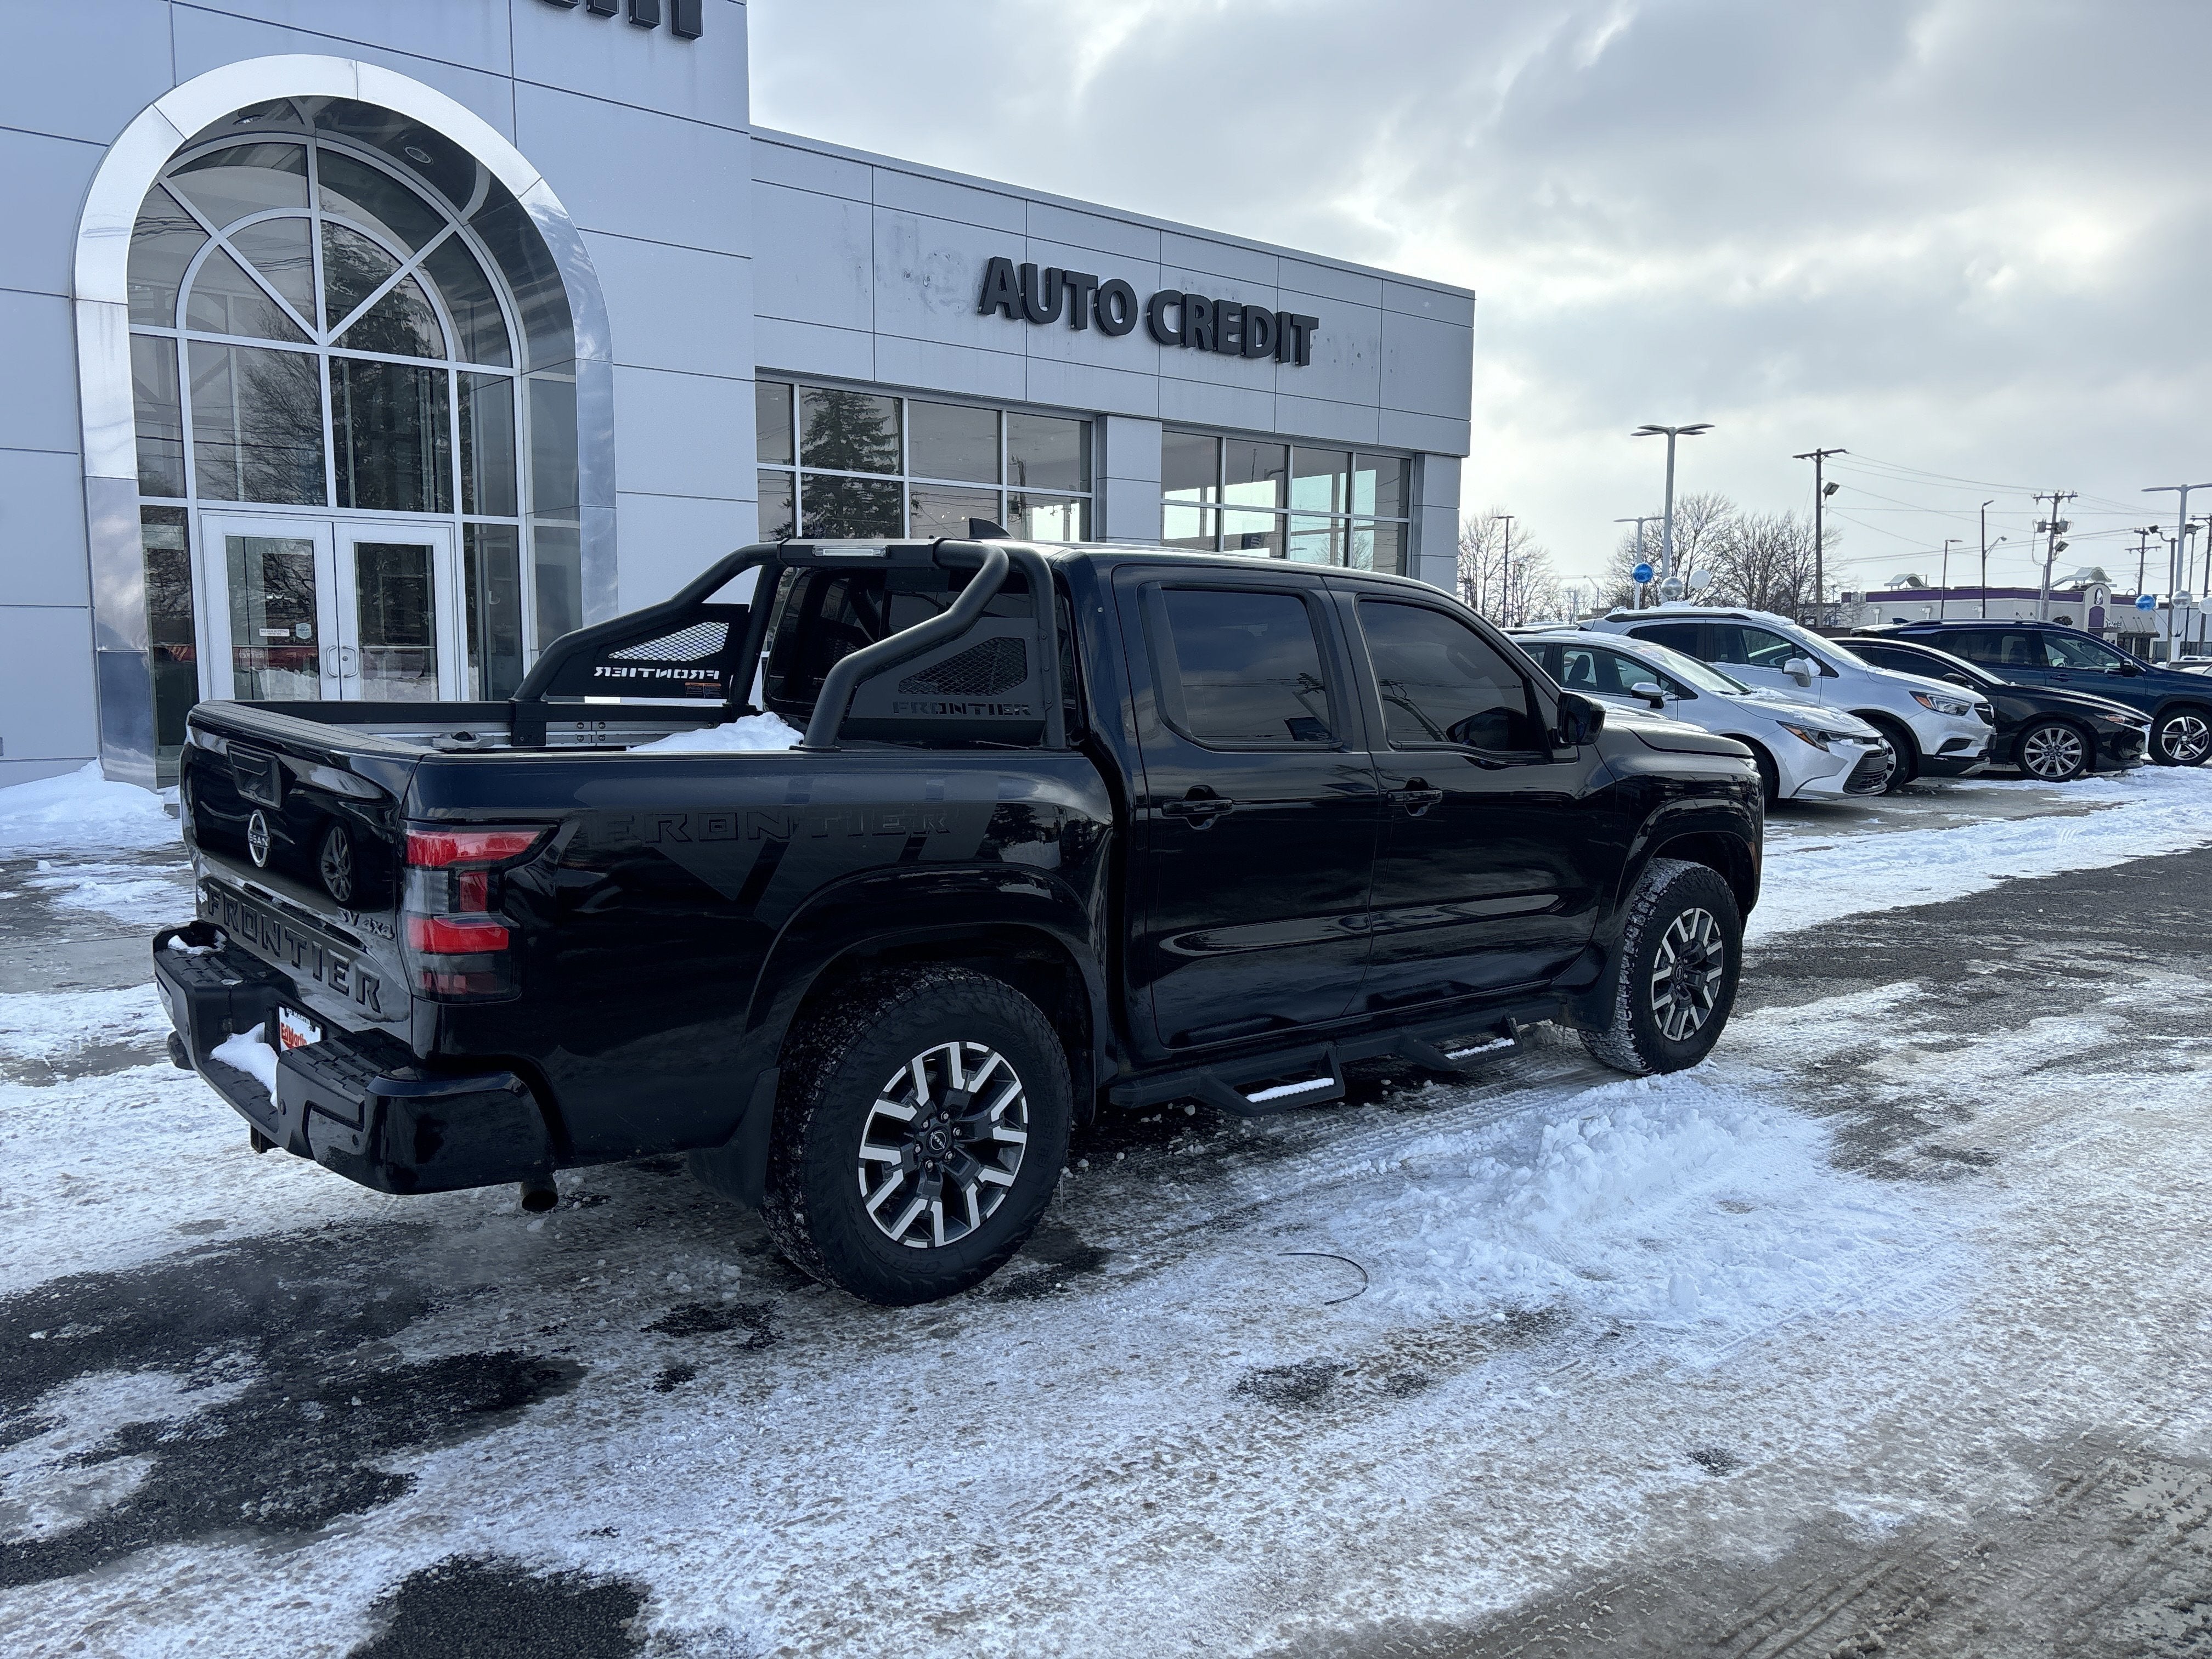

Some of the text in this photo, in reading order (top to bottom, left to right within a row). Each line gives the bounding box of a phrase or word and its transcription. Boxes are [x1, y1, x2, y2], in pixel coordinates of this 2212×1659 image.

[978, 256, 1319, 366] AUTO CREDIT
[892, 701, 1032, 716] FRONTIER
[589, 809, 958, 844] FRONTIER
[207, 882, 381, 1014] FRONTIER
